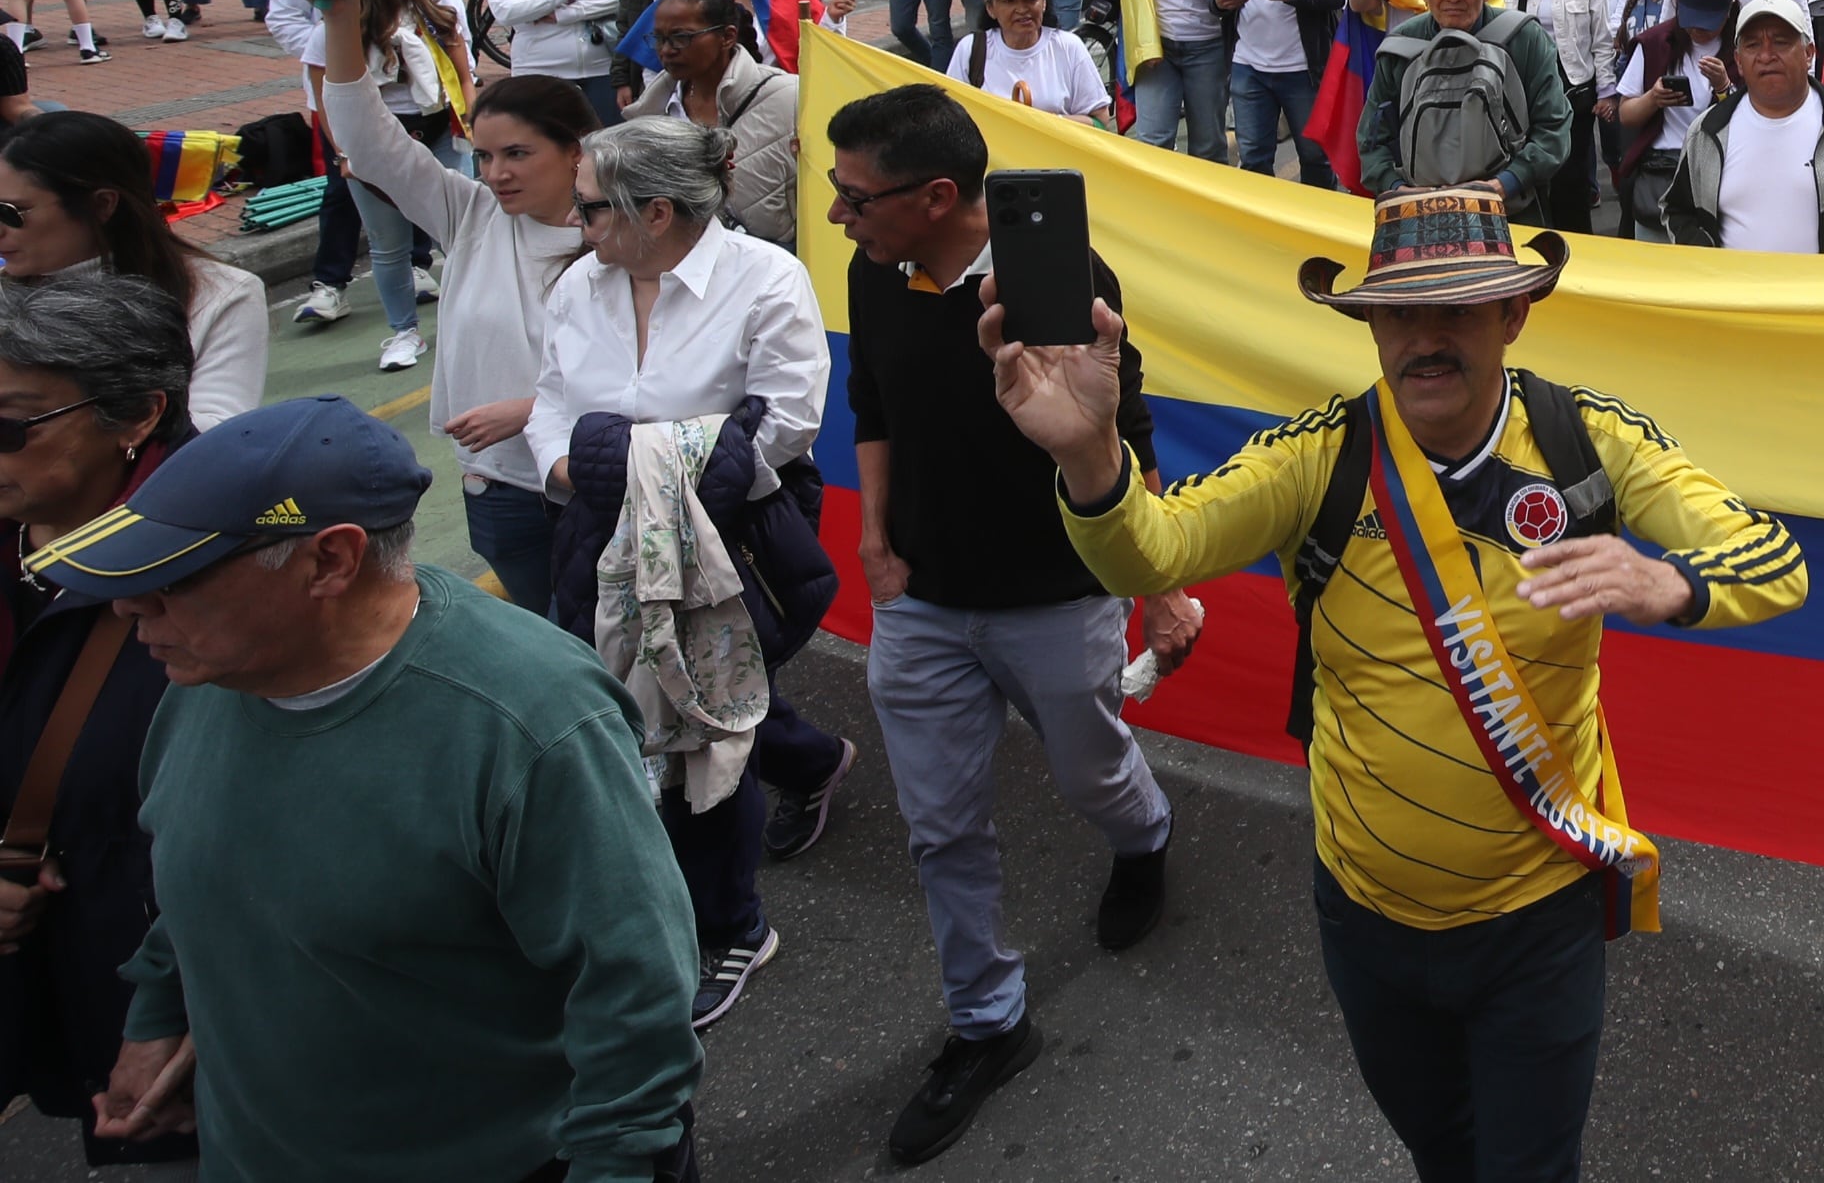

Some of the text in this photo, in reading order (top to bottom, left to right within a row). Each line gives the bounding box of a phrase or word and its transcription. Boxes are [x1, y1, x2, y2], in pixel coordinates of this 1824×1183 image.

[255, 514, 307, 525] adidas
[1434, 594, 1640, 865] VISITANTE ILUSTRE
